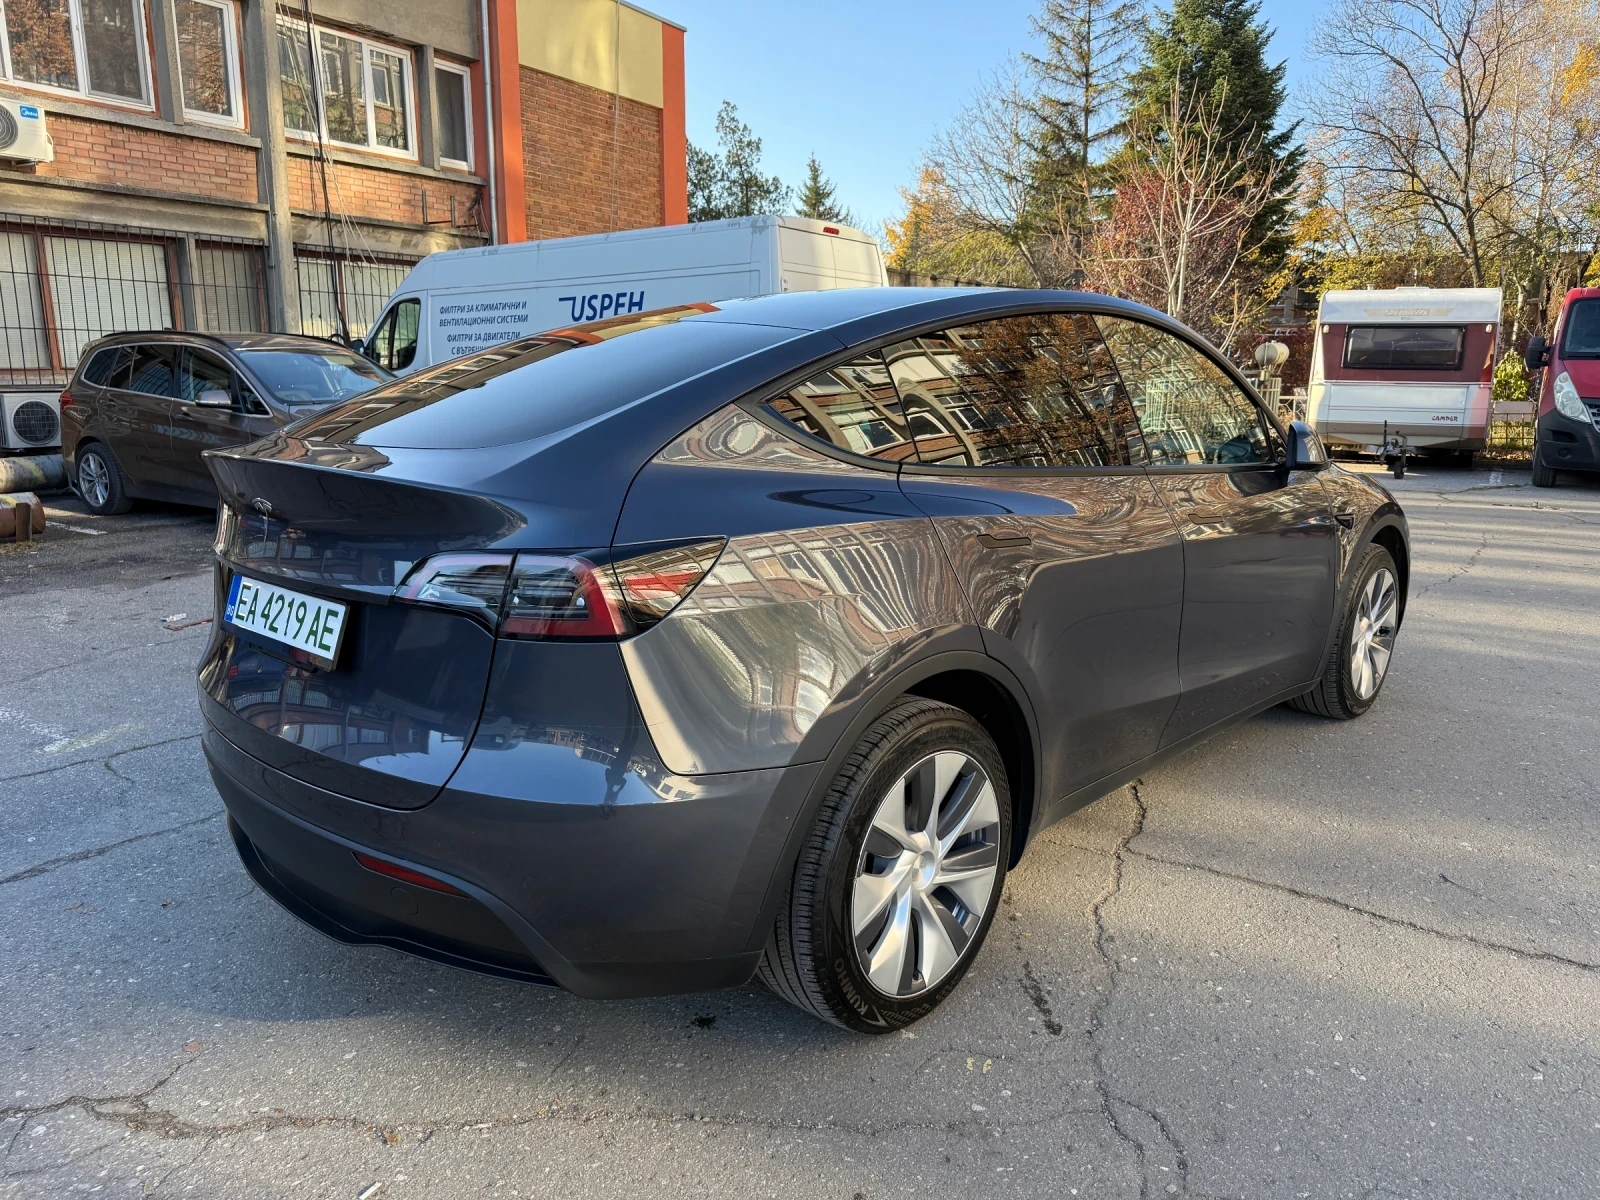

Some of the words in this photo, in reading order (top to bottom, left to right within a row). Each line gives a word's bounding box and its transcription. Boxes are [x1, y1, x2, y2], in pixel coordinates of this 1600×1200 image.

[439, 305, 466, 315] ФИЛТРИ
[466, 304, 474, 313] ЗА
[475, 301, 521, 312] КЛИМАТИЧНИ
[521, 300, 527, 310] И
[439, 315, 496, 327] ВЕНТИЛАЦИОННИ
[496, 314, 529, 324] СИСТЕМИ
[446, 333, 473, 343] ФИЛТРИ
[473, 333, 482, 342] ЗА
[482, 331, 521, 343] ДВИГАТЕЛИ
[235, 582, 260, 625] EA
[260, 591, 308, 640] 4219
[304, 605, 339, 652] AE
[834, 957, 869, 1016] KUMHO
